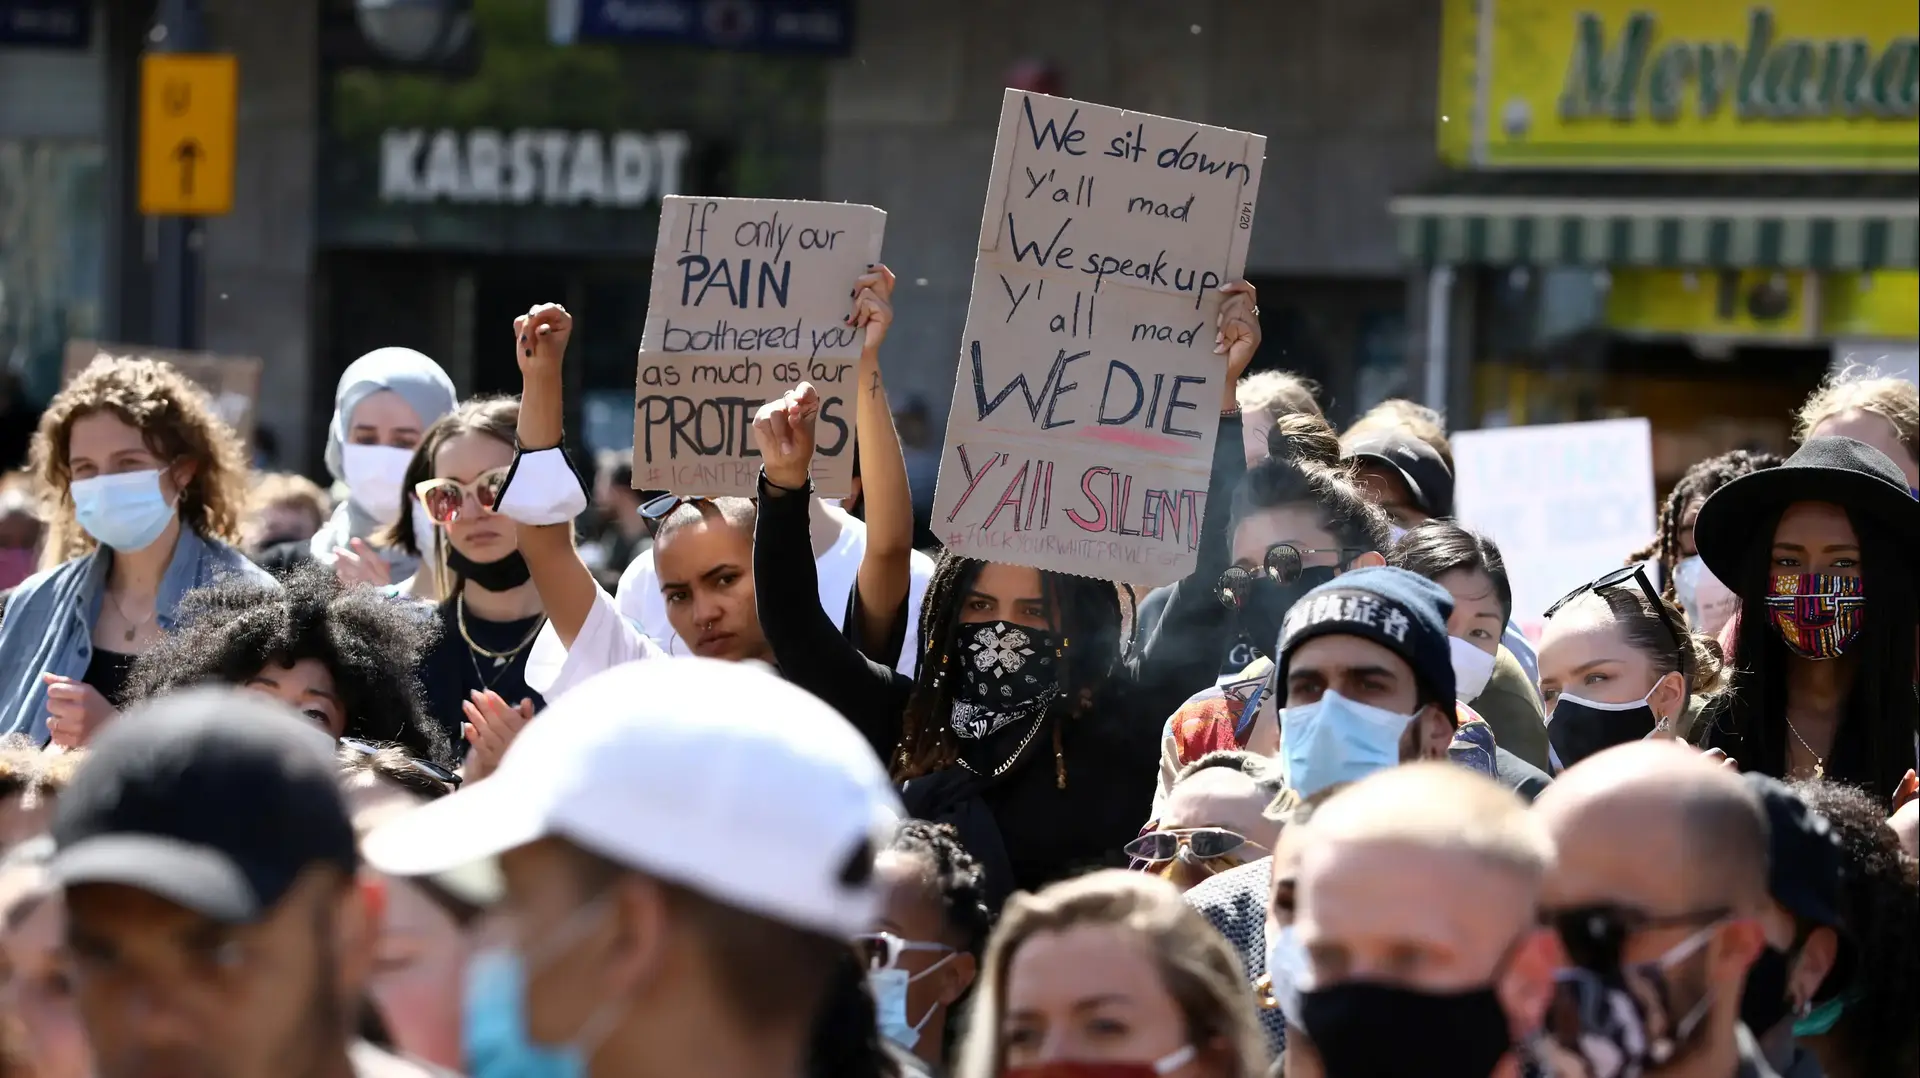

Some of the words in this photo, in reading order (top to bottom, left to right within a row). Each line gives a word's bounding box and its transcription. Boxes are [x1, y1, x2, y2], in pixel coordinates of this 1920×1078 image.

[379, 127, 690, 208] KARSTADT
[1023, 96, 1087, 156] We
[1104, 123, 1148, 163] sit
[1157, 131, 1250, 187] down
[1025, 166, 1095, 208] Y'all
[1128, 193, 1195, 223] mad
[1238, 200, 1253, 231] 14/20
[681, 201, 718, 256] If
[735, 210, 793, 264] only
[799, 227, 845, 251] our
[1007, 212, 1074, 270] We
[676, 255, 791, 309] PAIN
[662, 318, 802, 353] bothered
[808, 325, 860, 371] you
[1132, 322, 1204, 349] mad
[642, 364, 681, 387] as
[691, 357, 763, 387] much
[772, 361, 801, 383] as
[811, 362, 853, 384] our
[970, 340, 1091, 431] WE
[1096, 359, 1207, 440] DIE
[637, 395, 850, 464] PROTES
[1062, 466, 1209, 553] SILENT
